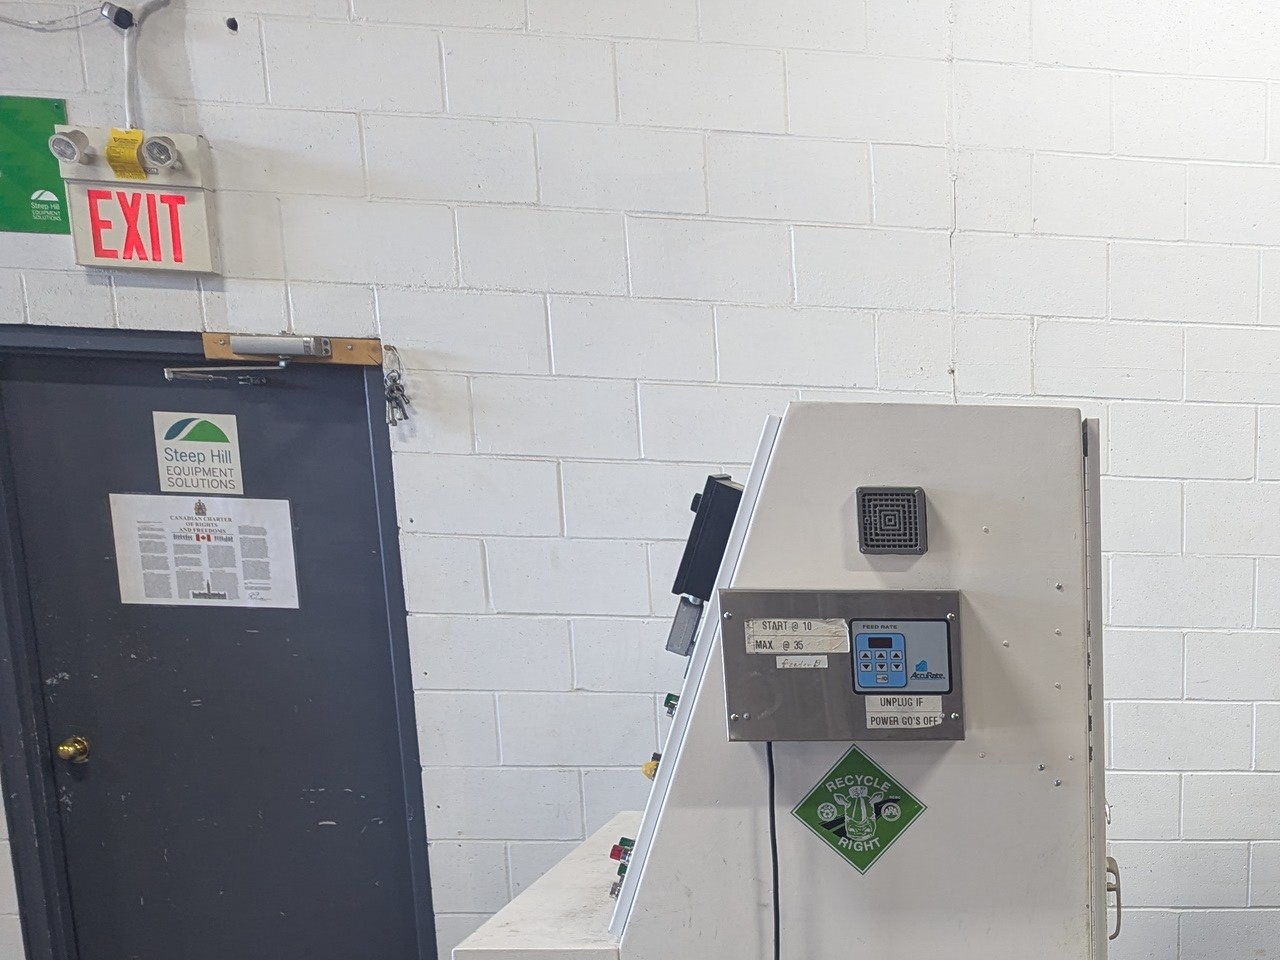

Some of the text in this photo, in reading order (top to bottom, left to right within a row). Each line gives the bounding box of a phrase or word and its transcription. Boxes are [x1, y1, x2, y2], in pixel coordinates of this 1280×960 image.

[30, 202, 49, 210] Steep
[87, 189, 186, 263] EXIT
[164, 446, 232, 465] Steep Hill
[166, 465, 234, 478] EQUIPMENT
[167, 476, 236, 490] SOLUTIONS
[762, 620, 788, 631] START
[803, 621, 813, 631] 10
[755, 639, 774, 650] MAX
[793, 640, 804, 650] 35
[909, 671, 946, 680] AccuRate
[880, 697, 924, 707] UNPLUG IF
[870, 716, 938, 726] POWER GO'S OFF
[825, 774, 891, 793] RECYCLE
[837, 836, 882, 853] RIGHT
